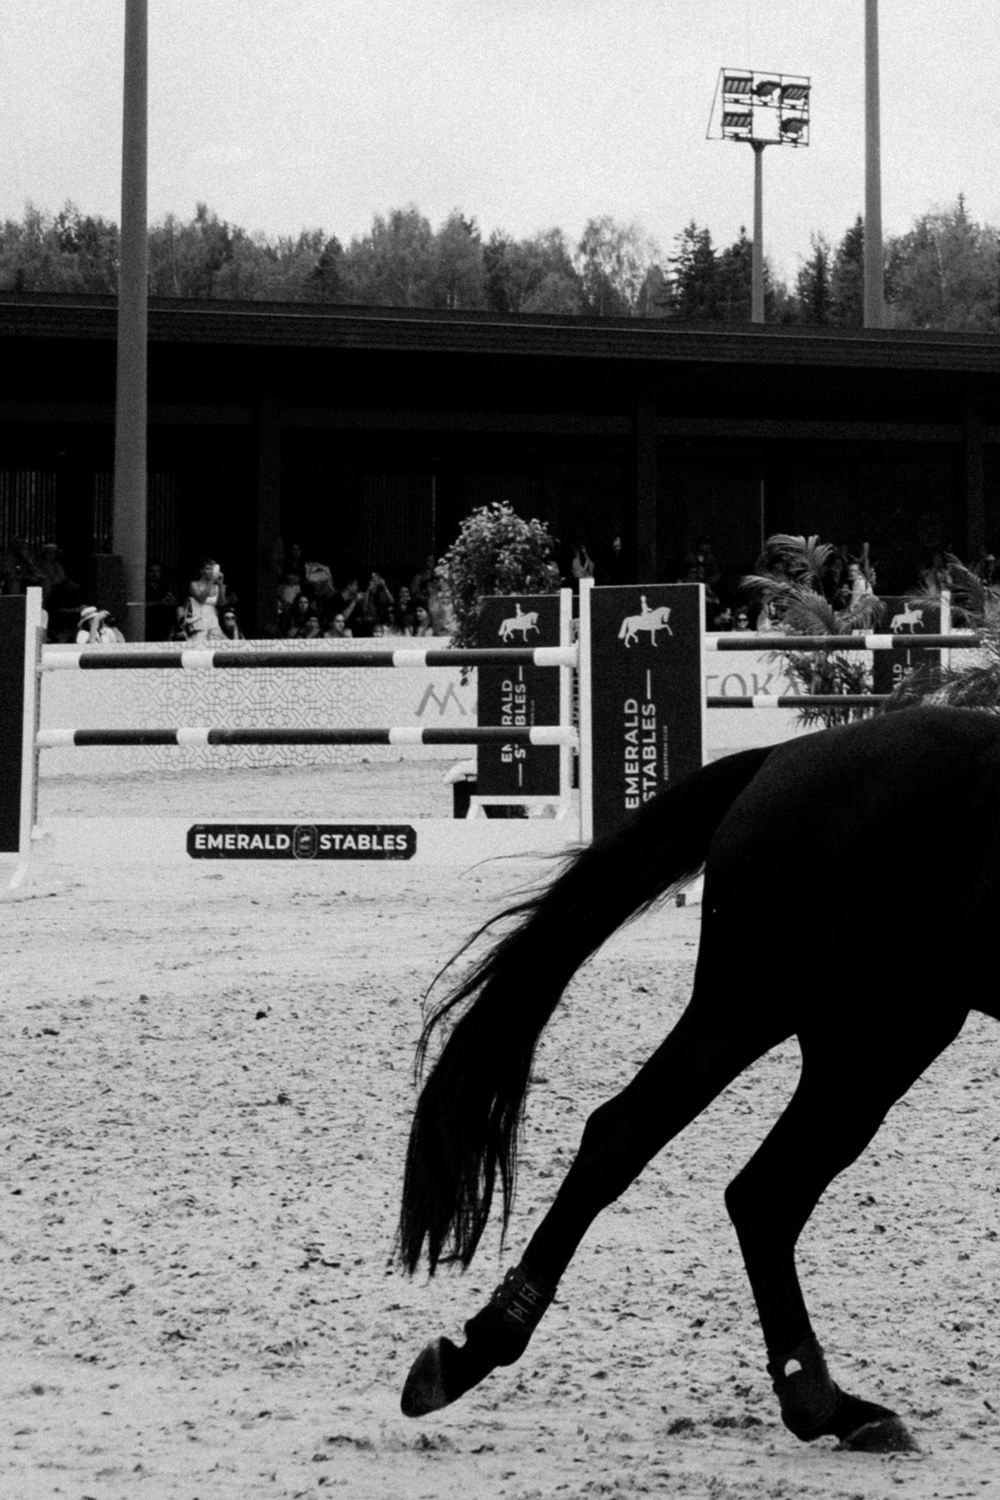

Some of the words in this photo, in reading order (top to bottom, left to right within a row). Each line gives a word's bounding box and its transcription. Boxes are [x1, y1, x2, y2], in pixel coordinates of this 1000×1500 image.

[501, 679, 513, 763] EMRALD
[514, 683, 526, 759] SBLES
[624, 698, 640, 809] EMERALD
[641, 703, 657, 802] STABLES
[194, 833, 291, 850] EMERALD
[319, 833, 408, 850] STABLES
